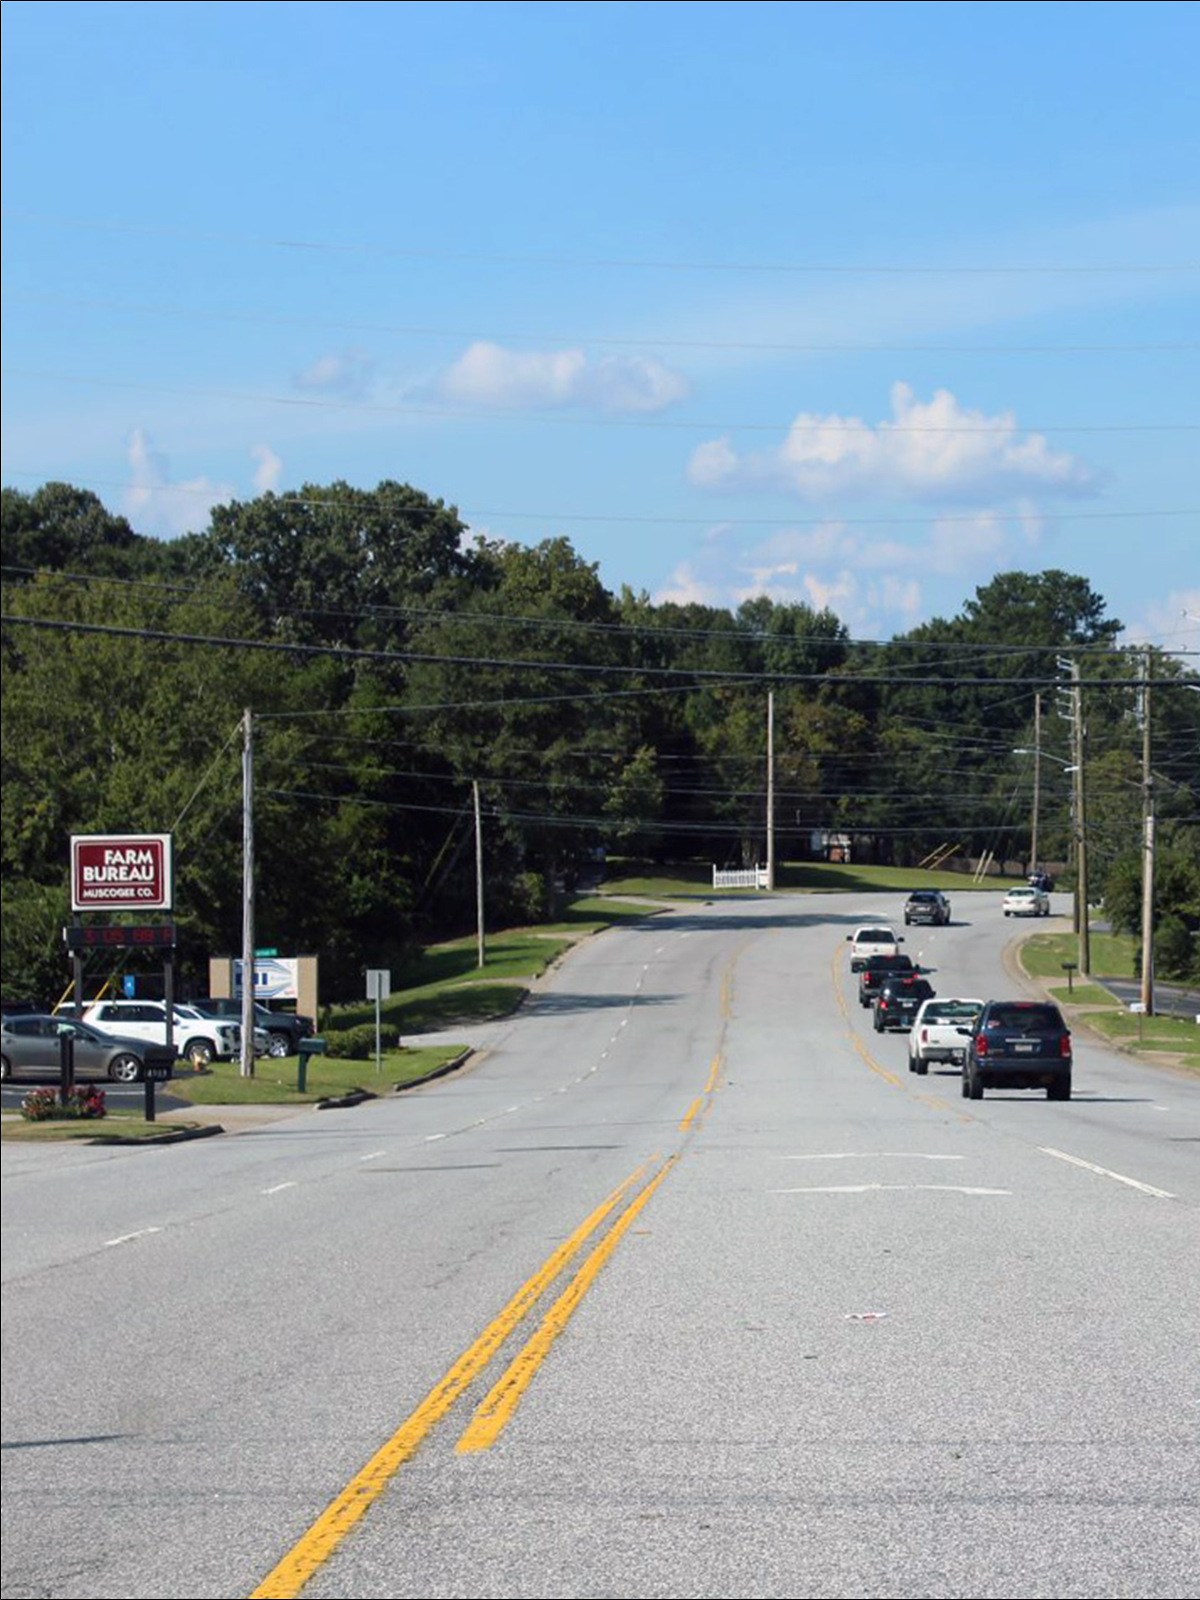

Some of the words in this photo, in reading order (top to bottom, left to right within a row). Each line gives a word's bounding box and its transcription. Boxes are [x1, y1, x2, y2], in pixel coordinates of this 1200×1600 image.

[104, 849, 154, 865] FARM
[83, 866, 154, 882] BUREAU
[83, 888, 135, 898] MUSCOGEE
